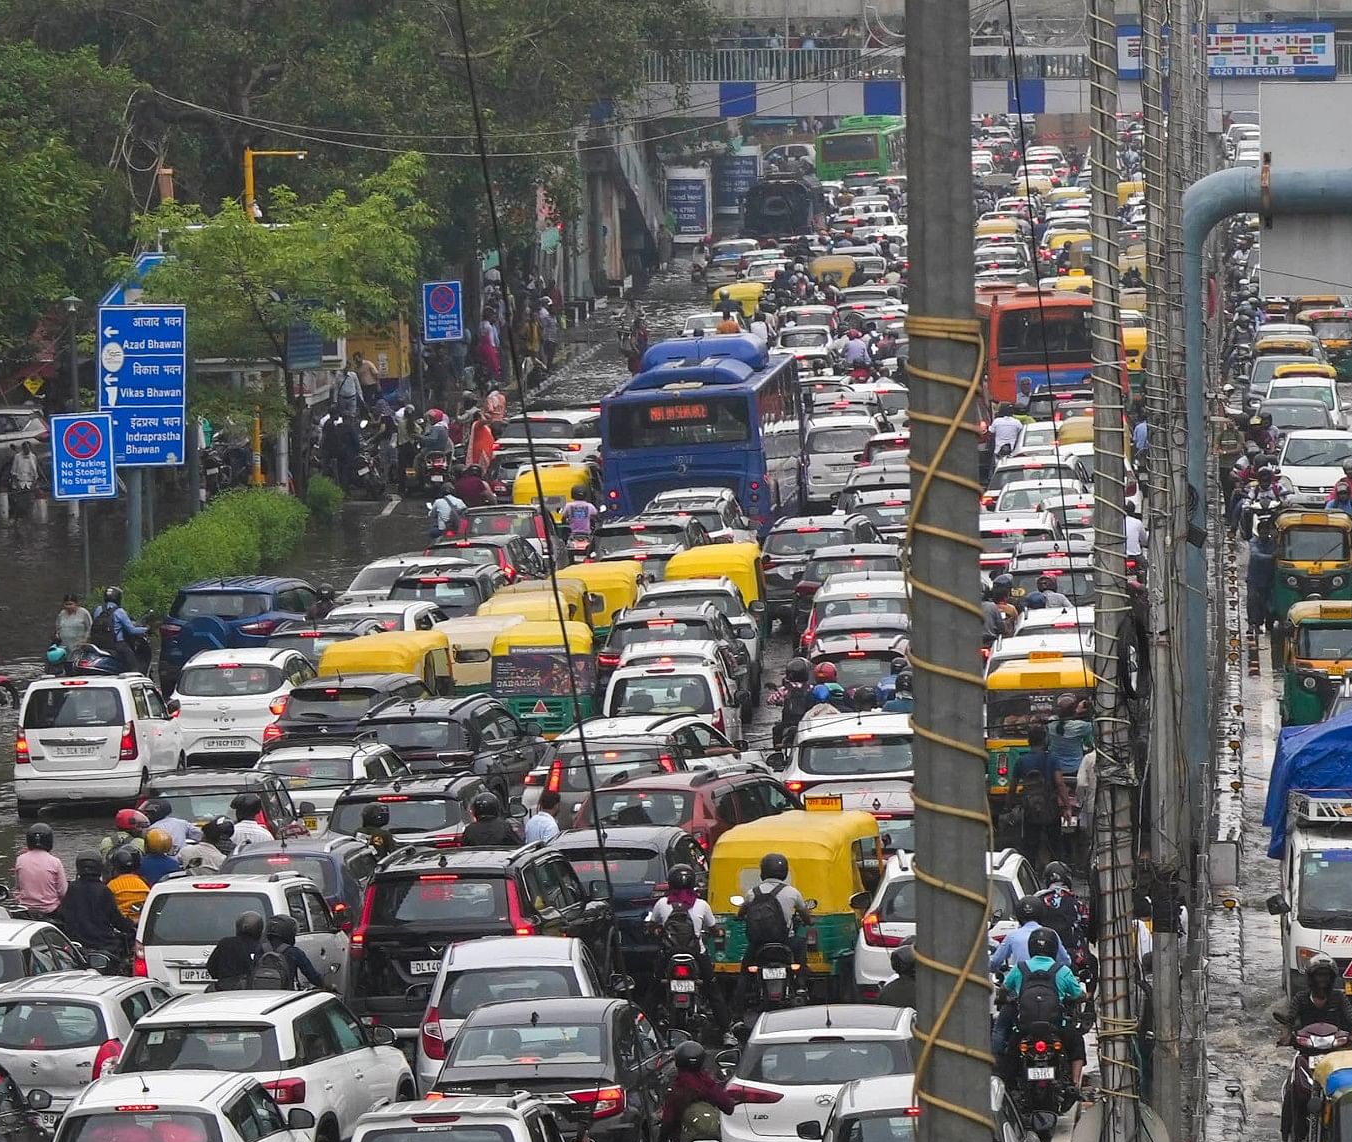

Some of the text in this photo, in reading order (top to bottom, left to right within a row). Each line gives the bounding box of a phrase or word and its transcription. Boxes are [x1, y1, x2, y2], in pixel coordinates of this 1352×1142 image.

[1214, 65, 1296, 75] G20 DELEGATES
[133, 317, 182, 328] आजाद भवन
[123, 339, 183, 350] Azad Bhawan
[133, 361, 182, 376] विकास भवन
[120, 388, 182, 398] Vikas Bhawan
[161, 416, 182, 428] भवन
[125, 432, 181, 444] Indraprastha
[125, 445, 161, 455] Bhawan
[61, 460, 106, 470] No Parking
[61, 469, 73, 477] No
[61, 477, 107, 487] No Standing
[1322, 935, 1338, 944] THE
